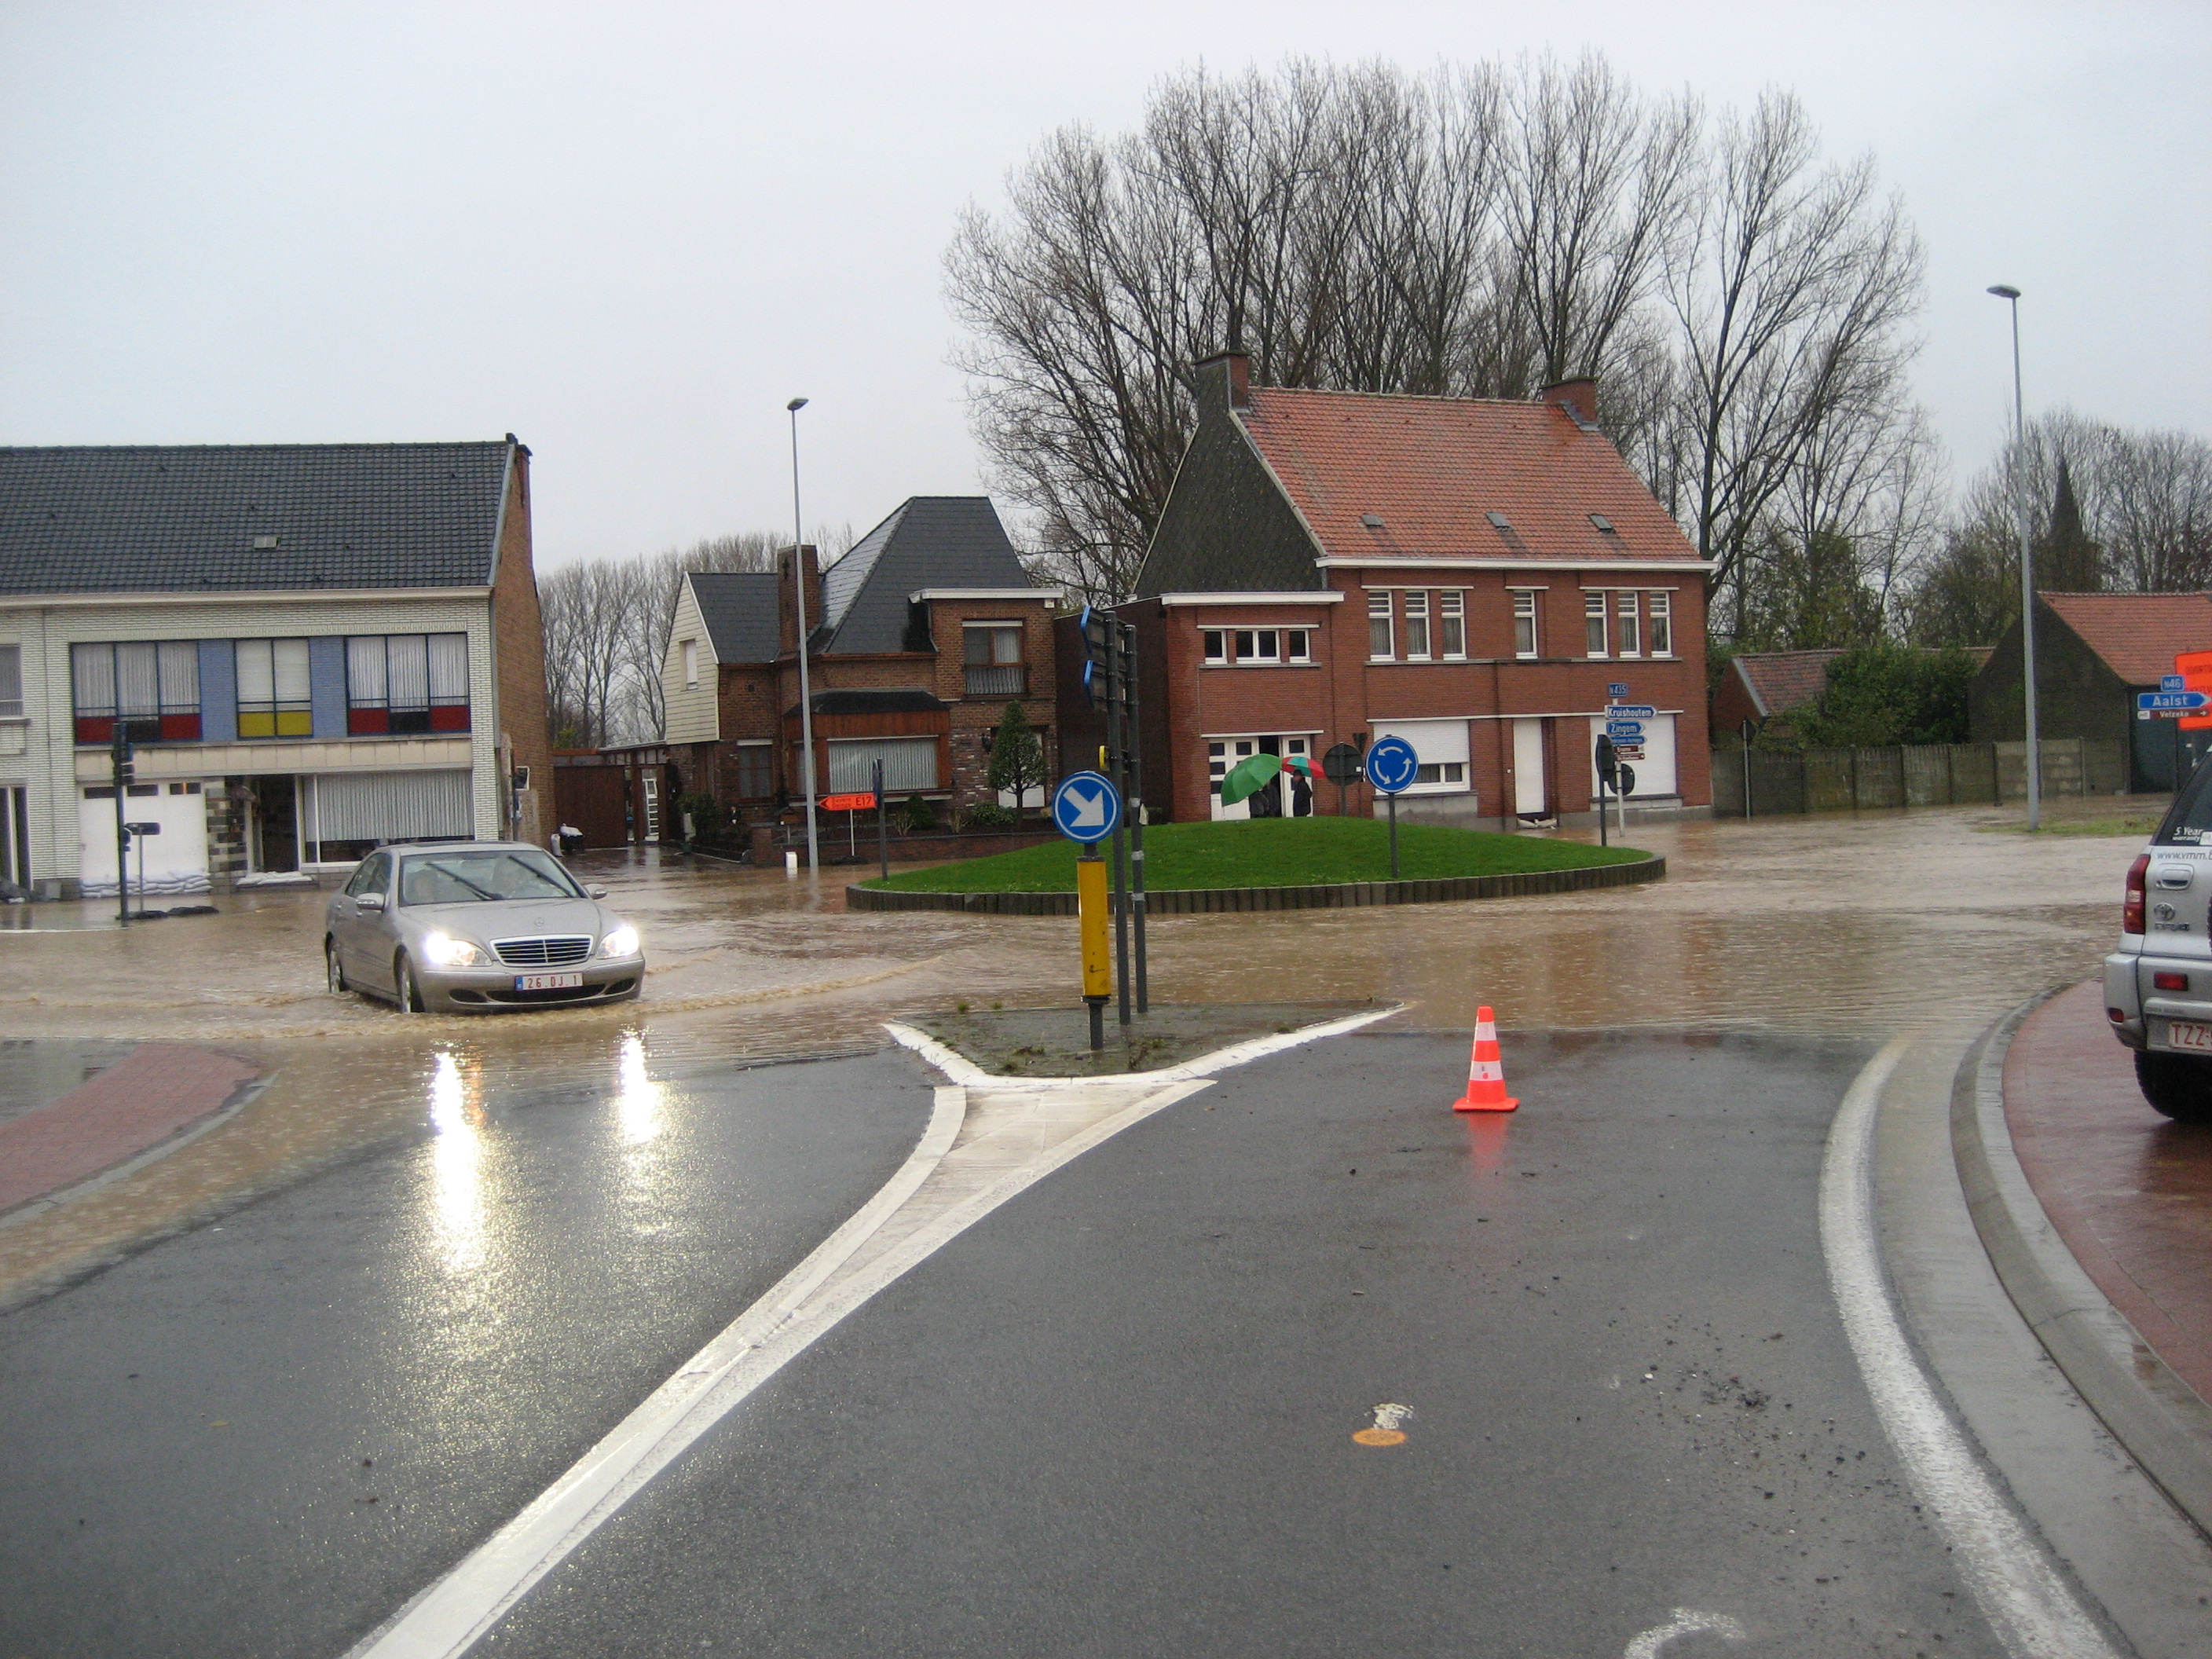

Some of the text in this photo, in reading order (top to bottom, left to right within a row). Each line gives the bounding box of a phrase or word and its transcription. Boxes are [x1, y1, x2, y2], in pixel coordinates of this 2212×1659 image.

[2164, 678, 2181, 688] N46
[2152, 695, 2188, 707] Aalst
[1608, 708, 1652, 718] Kruishoutem
[1611, 724, 1637, 734] Zingem
[855, 796, 872, 806] E17
[2174, 826, 2203, 836] 5 Year
